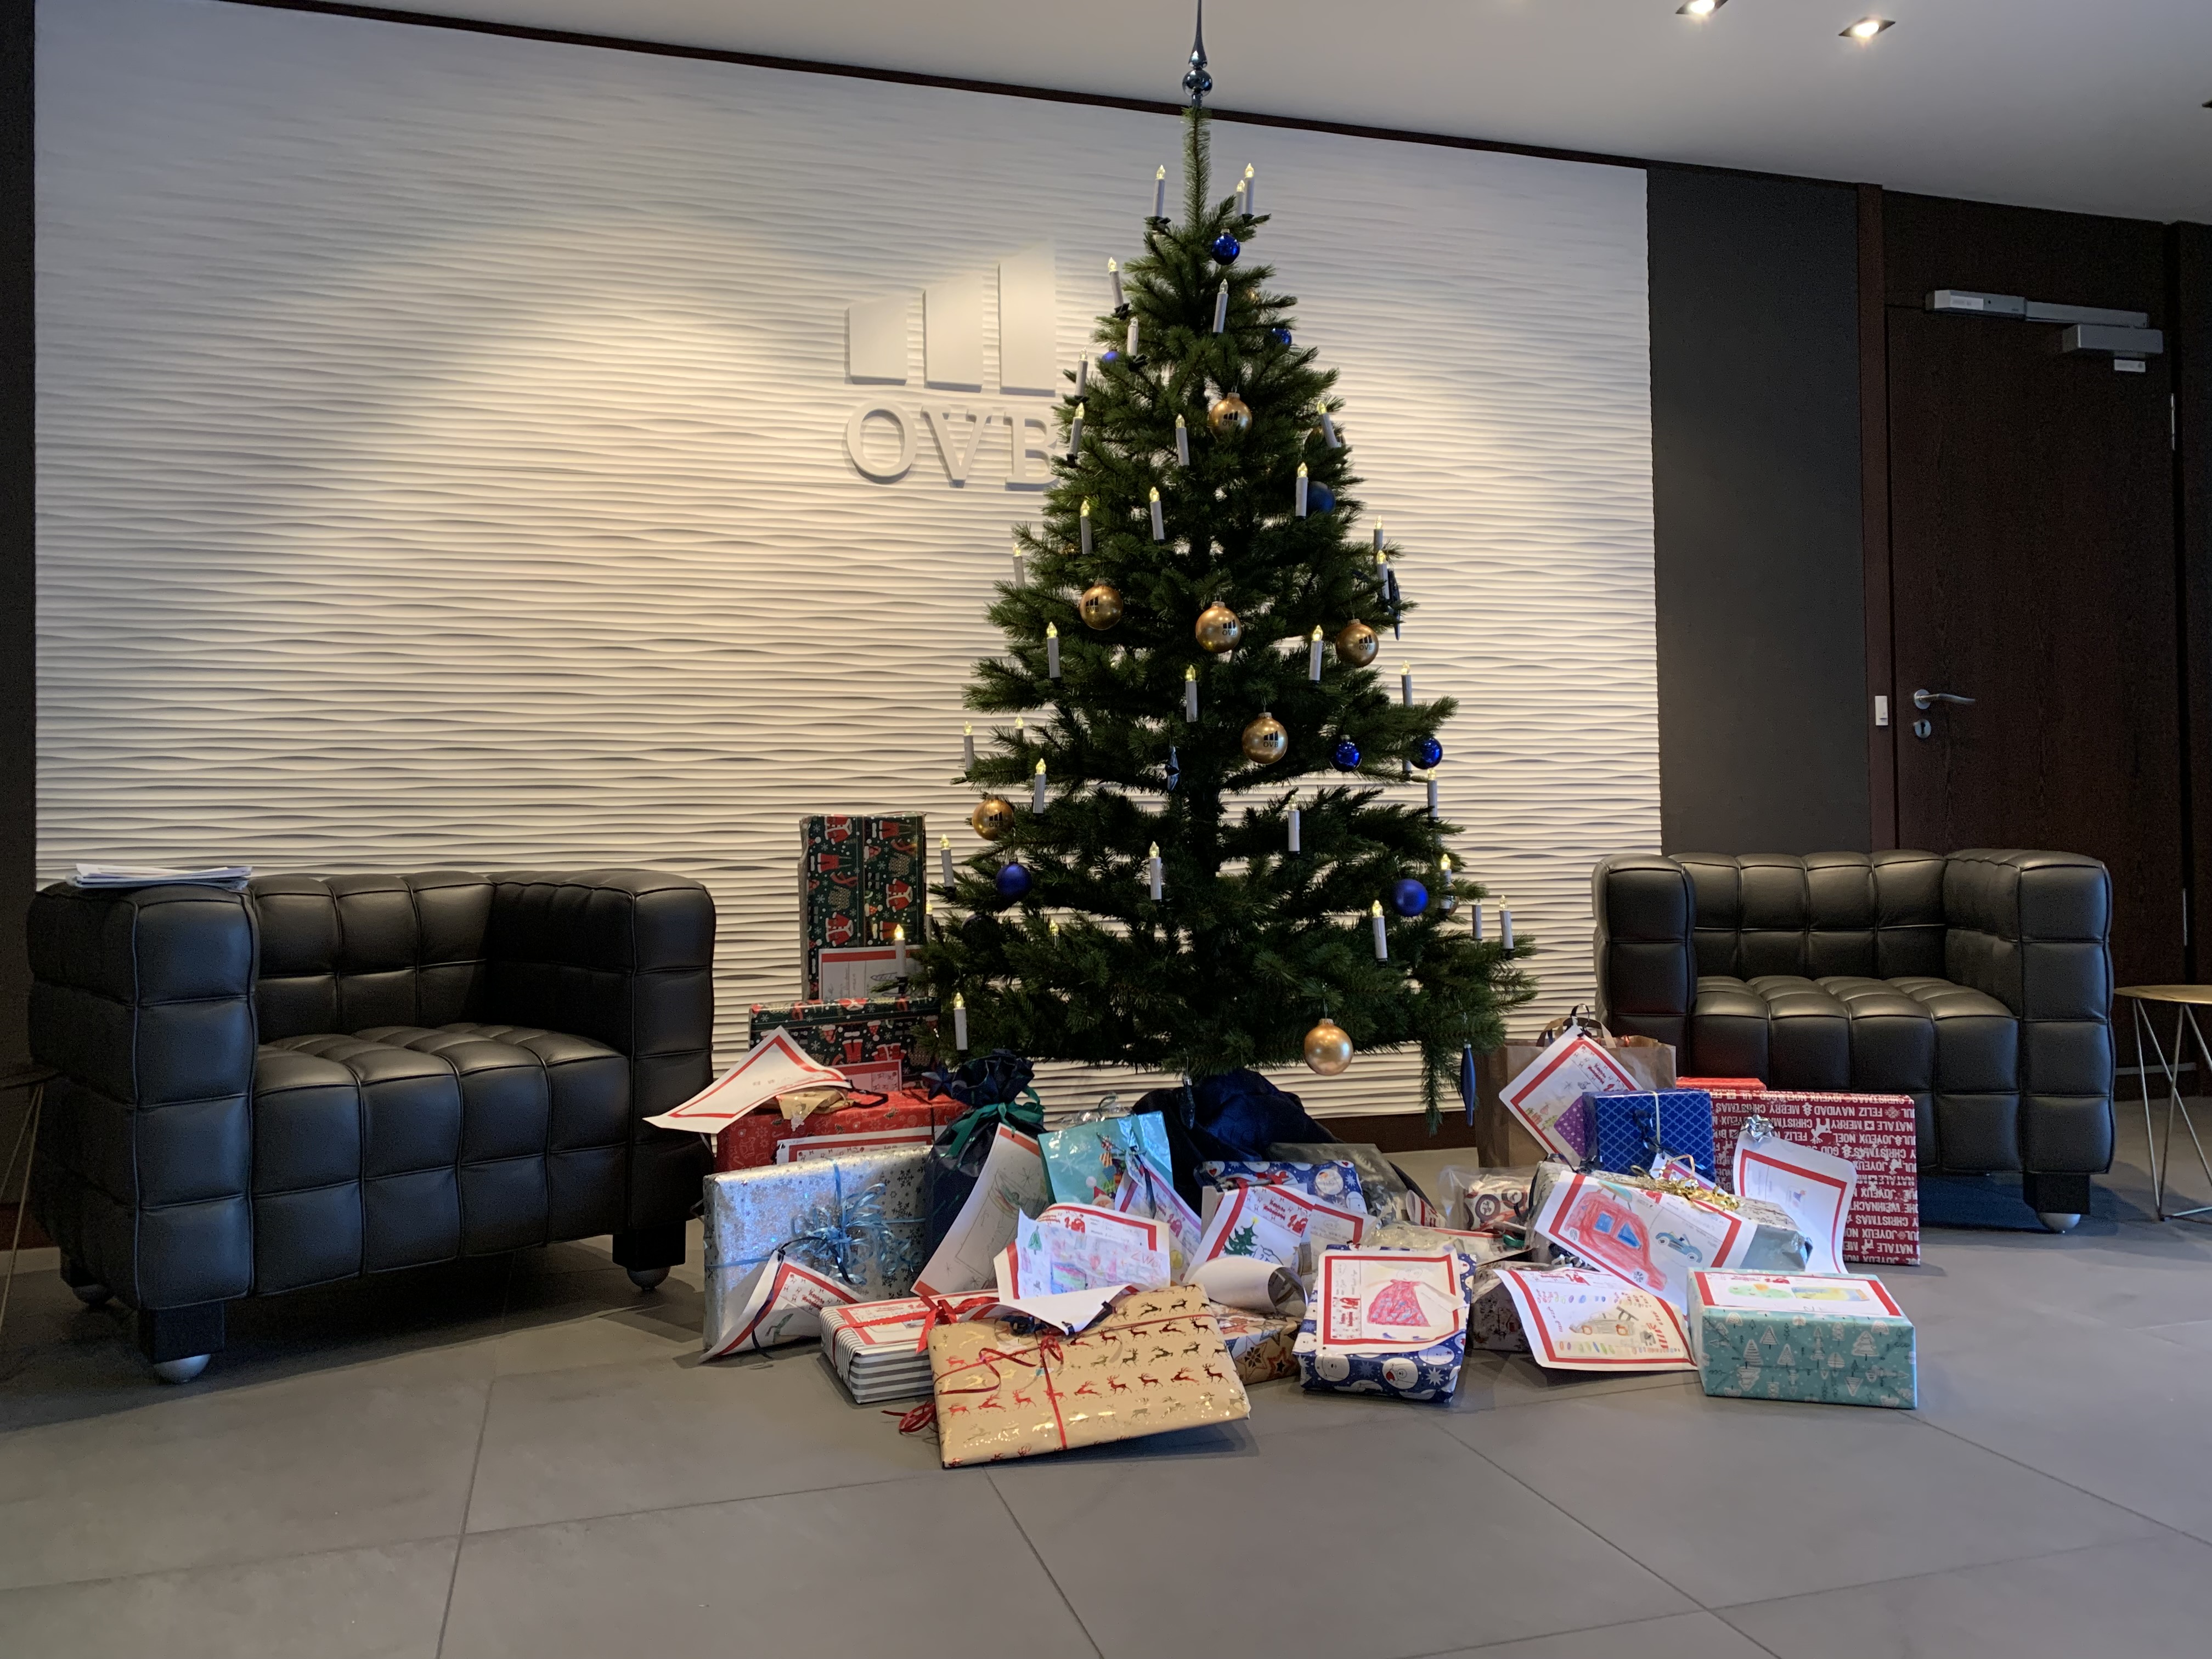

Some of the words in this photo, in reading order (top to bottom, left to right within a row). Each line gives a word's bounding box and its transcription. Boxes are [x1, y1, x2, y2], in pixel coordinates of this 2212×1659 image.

[845, 399, 1059, 490] OVB
[1716, 1102, 1766, 1113] CHRISTMAS
[1769, 1104, 1800, 1115] MERRY
[1814, 1105, 1855, 1116] NAVIDAD
[1858, 1107, 1883, 1117] FELIZ
[1831, 1120, 1863, 1130] MERRY
[1876, 1121, 1913, 1132] NATALE
[1782, 1131, 1808, 1142] FELIZ
[1832, 1133, 1856, 1144] NOEL
[1859, 1133, 1894, 1145] JOYEUX
[1820, 1146, 1839, 1156] GOD
[1853, 1147, 1906, 1159] CHRISTMAS
[1852, 1160, 1888, 1171] JOYEUX
[1878, 1175, 1915, 1186] NATALE
[1861, 1188, 1896, 1200] JOYEUX
[1855, 1215, 1909, 1227] CHRISTMAS
[1862, 1228, 1898, 1240] JOYEUX
[1876, 1243, 1913, 1255] NATALE
